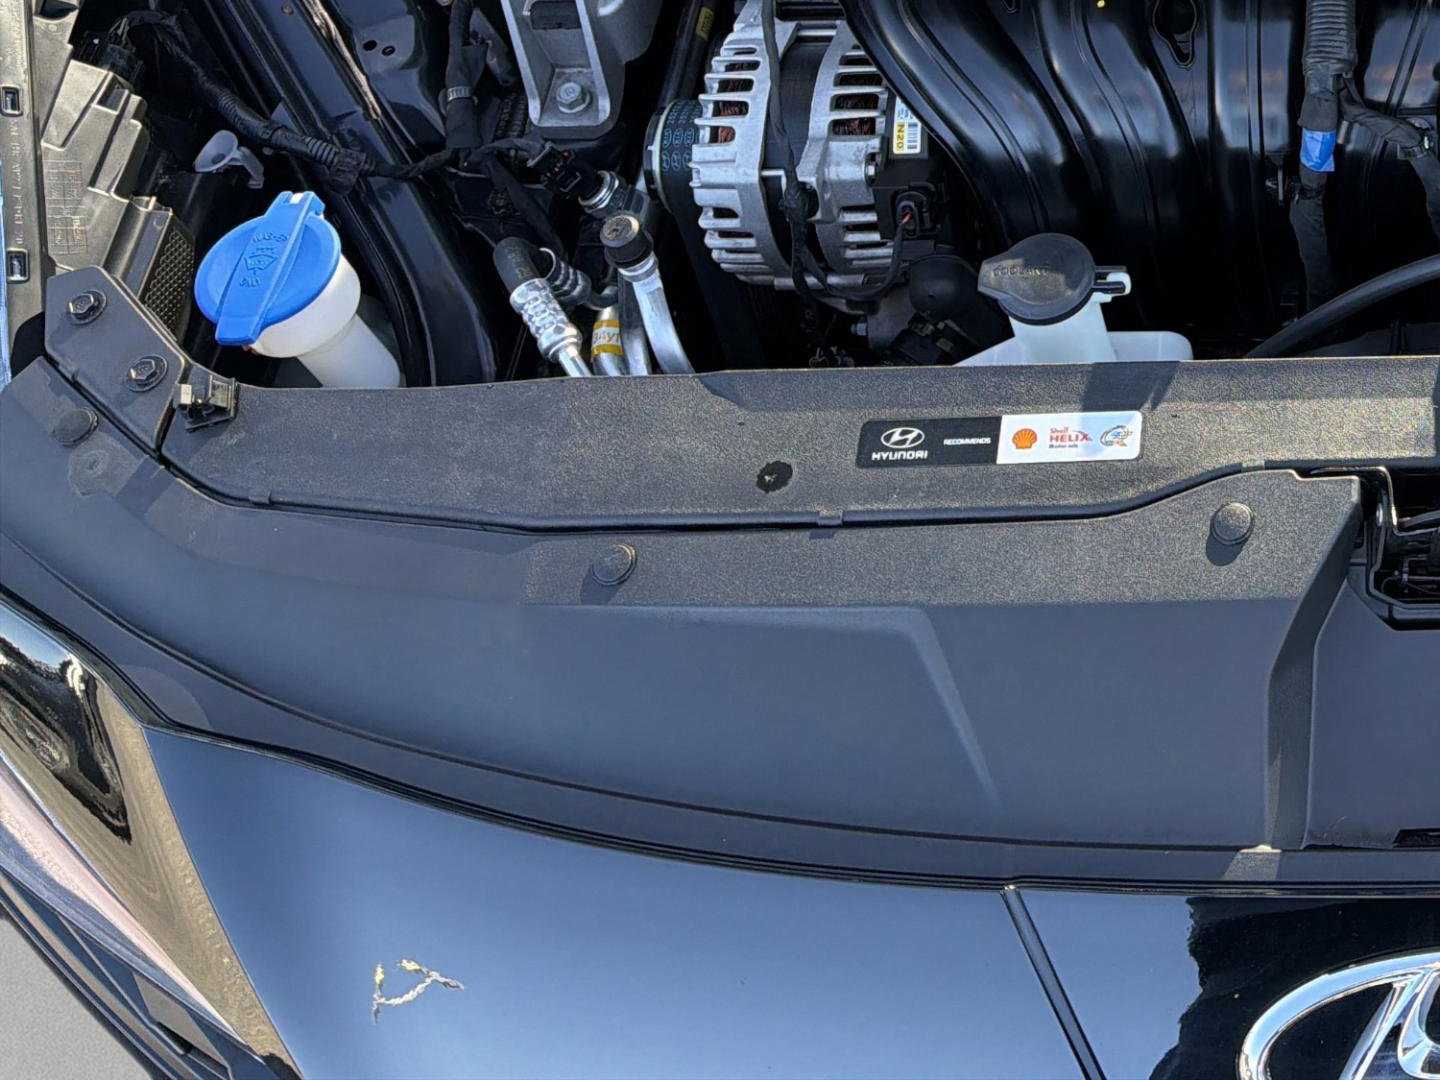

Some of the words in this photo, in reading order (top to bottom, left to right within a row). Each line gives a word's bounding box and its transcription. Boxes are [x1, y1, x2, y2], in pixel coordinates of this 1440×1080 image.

[943, 437, 991, 446] RECOMMENDS
[1050, 432, 1091, 442] HELIX
[871, 450, 928, 461] HYUNDAI
